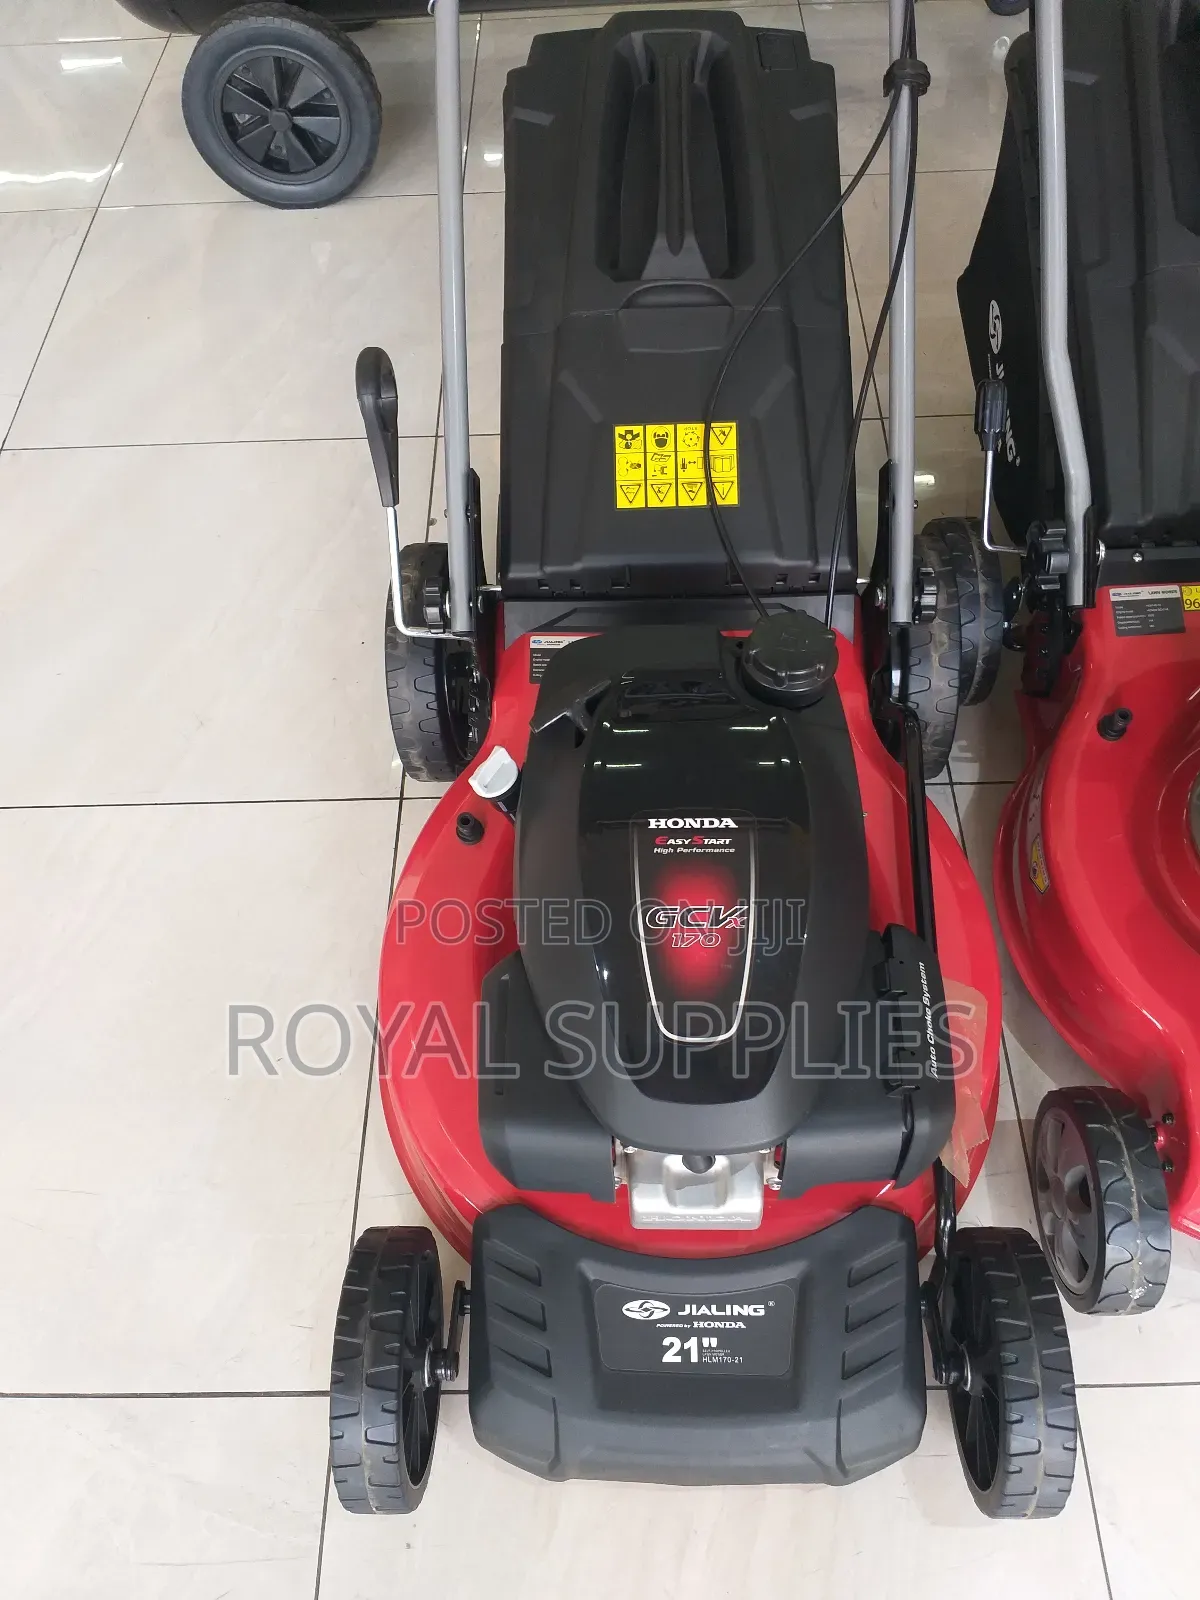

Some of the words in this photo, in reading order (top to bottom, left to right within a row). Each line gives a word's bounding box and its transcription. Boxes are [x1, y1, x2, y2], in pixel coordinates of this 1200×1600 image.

[648, 818, 738, 829] HONDA
[671, 933, 721, 948] 170
[919, 961, 931, 1006] System
[925, 1007, 935, 1045] Choke
[930, 1046, 939, 1079] Auto
[677, 1304, 766, 1317] JIALING
[693, 1321, 747, 1329] HONDA
[661, 1336, 718, 1363] 21"
[702, 1356, 743, 1364] HLM170-21
